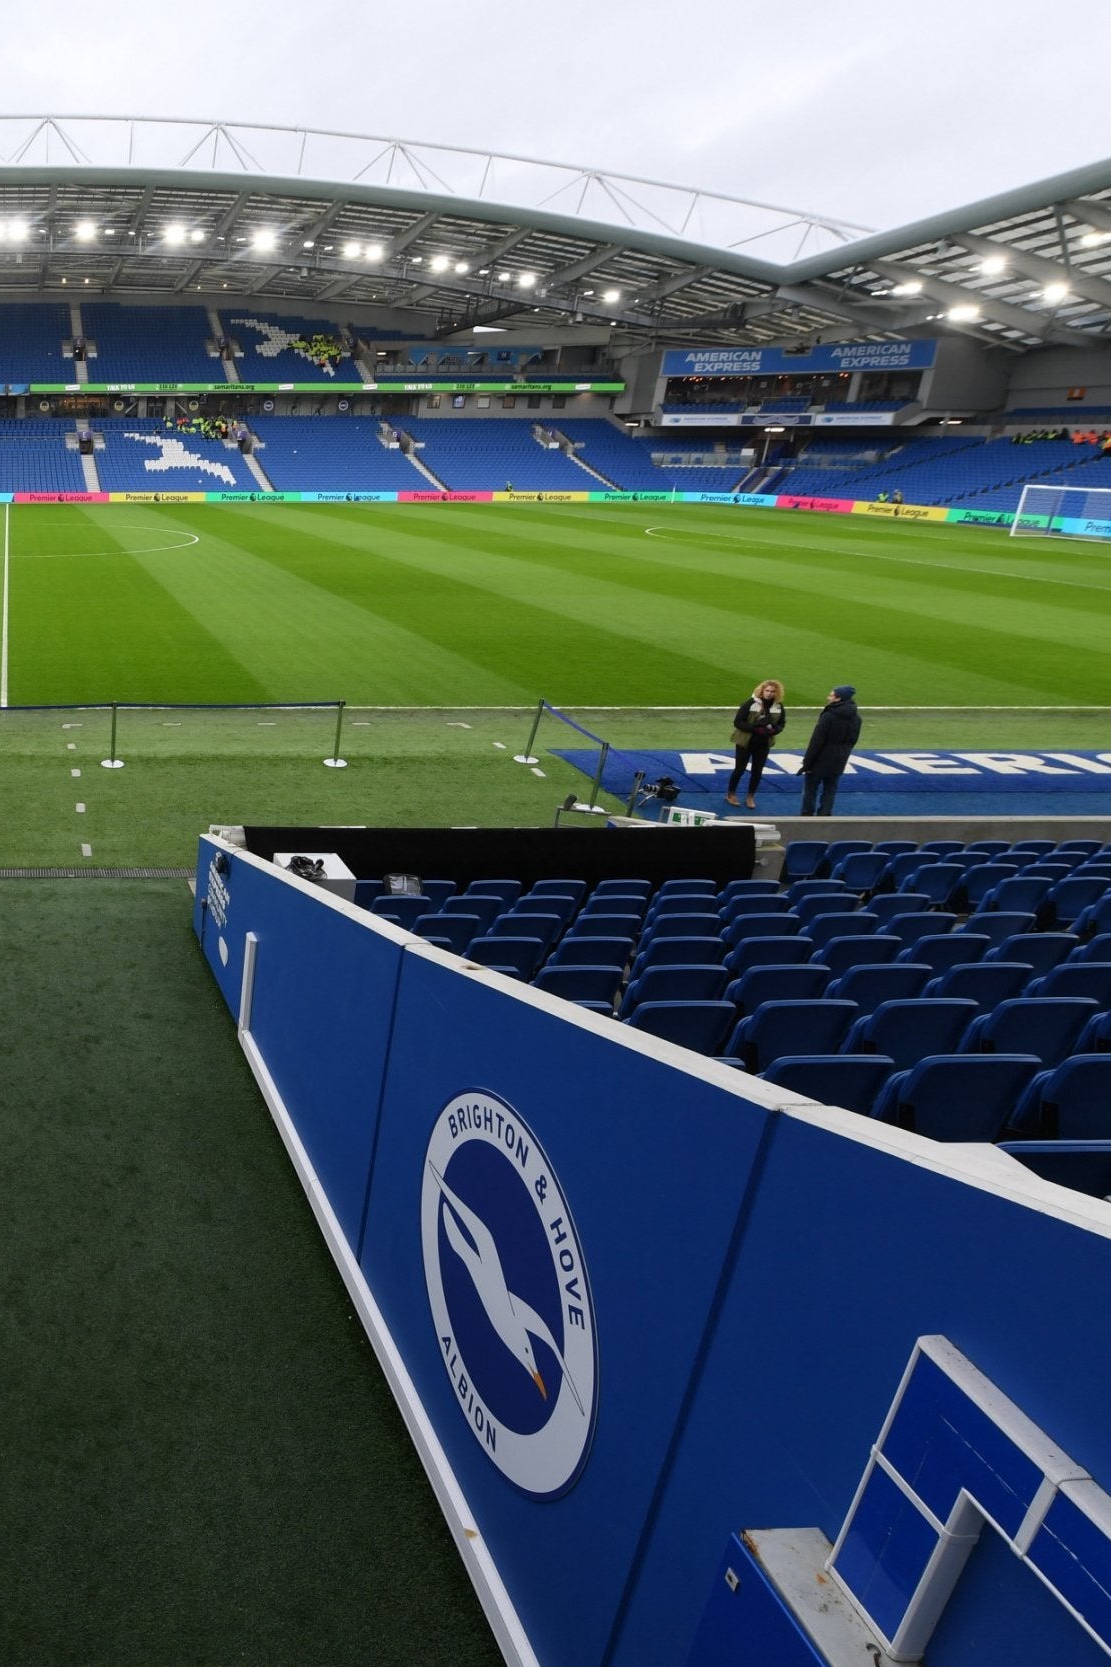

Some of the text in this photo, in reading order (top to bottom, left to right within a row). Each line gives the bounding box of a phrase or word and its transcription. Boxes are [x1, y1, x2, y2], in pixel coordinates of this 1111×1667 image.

[831, 344, 911, 357] AMERICAN
[685, 352, 762, 362] AMERICAN
[840, 355, 910, 368] EXPRESS
[694, 362, 761, 372] EXPRESS
[449, 493, 476, 501] League
[544, 493, 571, 501] League
[639, 493, 666, 501] League
[700, 493, 732, 502] Premier
[867, 504, 929, 519] Premier League
[963, 511, 995, 522] Premier
[680, 753, 1111, 774] AMERI
[448, 1104, 586, 1330] BRIGHTON & HOVE
[440, 1335, 497, 1453] ALBION
